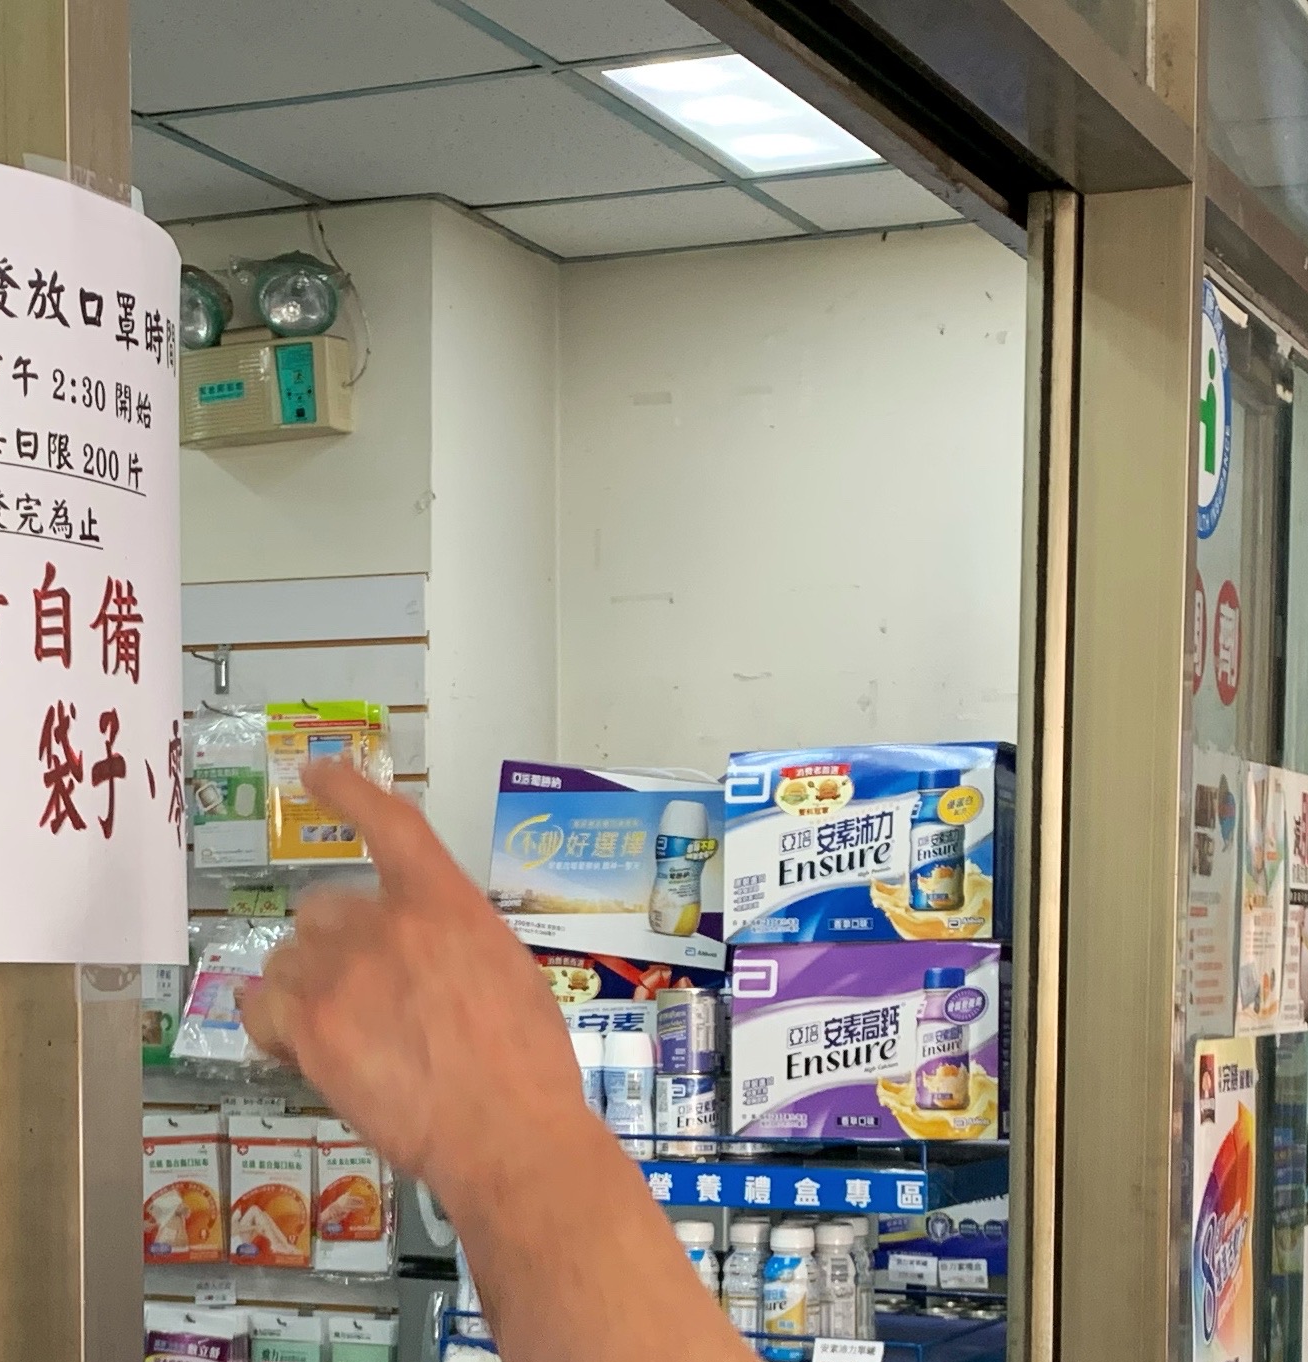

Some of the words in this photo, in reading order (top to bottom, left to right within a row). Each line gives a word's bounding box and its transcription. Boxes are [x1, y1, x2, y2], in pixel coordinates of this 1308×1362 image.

[781, 828, 813, 853] 亞培
[816, 811, 894, 856] 安素沛力
[778, 840, 892, 887] Ensure
[788, 1025, 819, 1047] 亞培
[823, 1004, 901, 1050] 安素高鈣
[785, 1037, 898, 1081] Ensure
[648, 1171, 925, 1210] 營養禮盒專區
